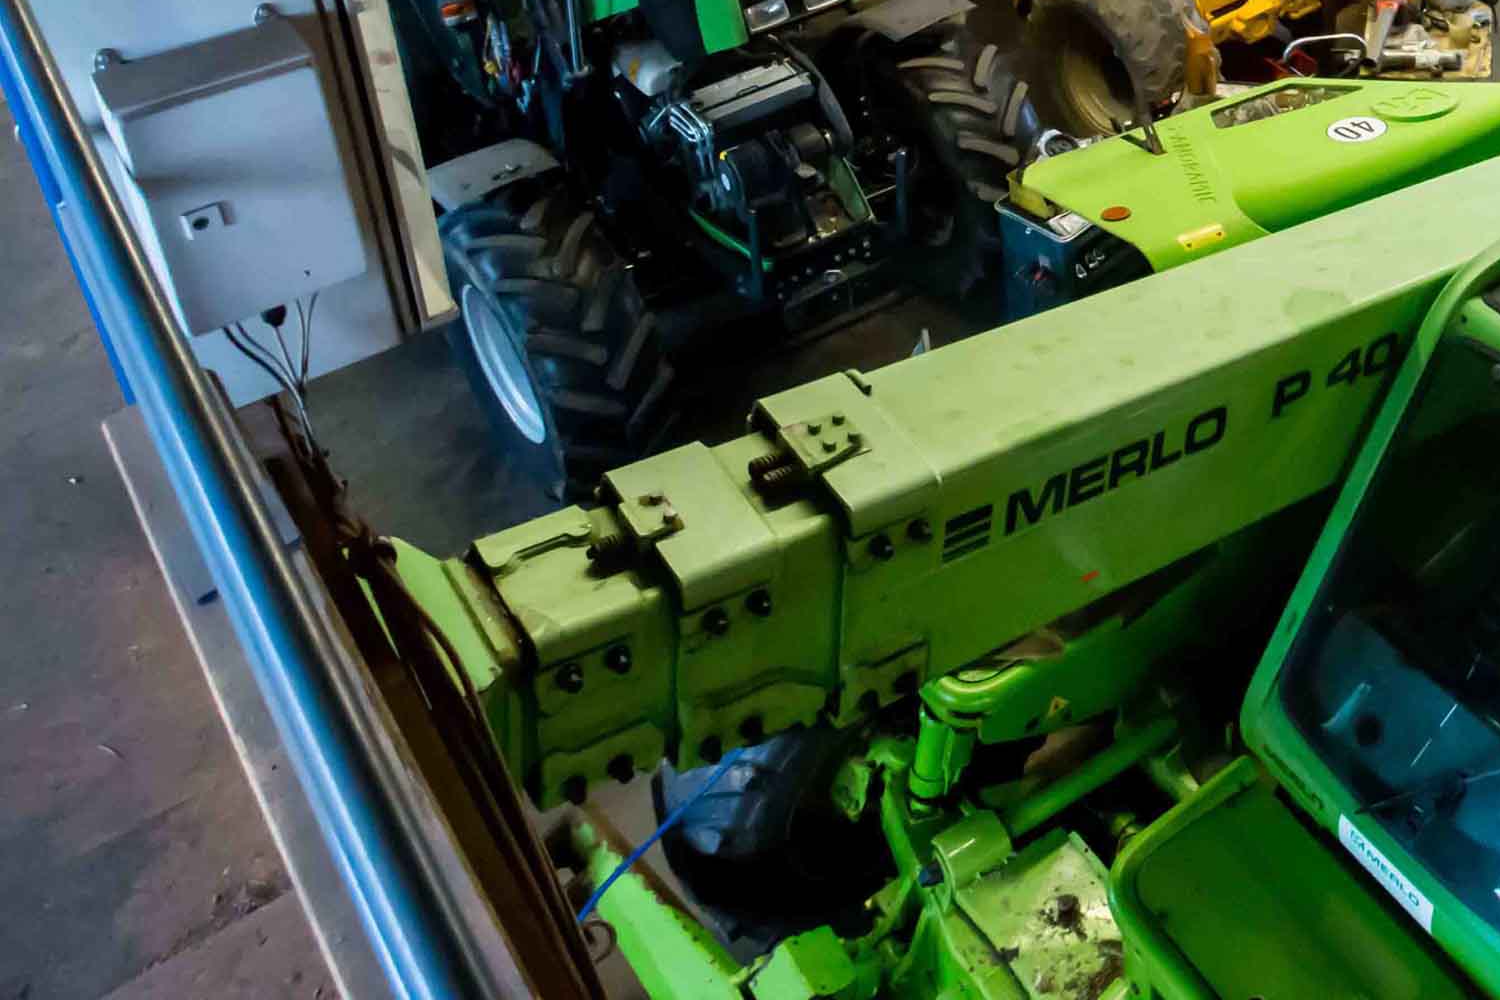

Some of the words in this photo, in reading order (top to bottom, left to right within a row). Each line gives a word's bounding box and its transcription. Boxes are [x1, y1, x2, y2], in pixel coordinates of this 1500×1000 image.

[1334, 120, 1376, 141] 40
[1004, 406, 1228, 537] MERLO
[1270, 370, 1313, 418] P
[1326, 332, 1399, 388] 40
